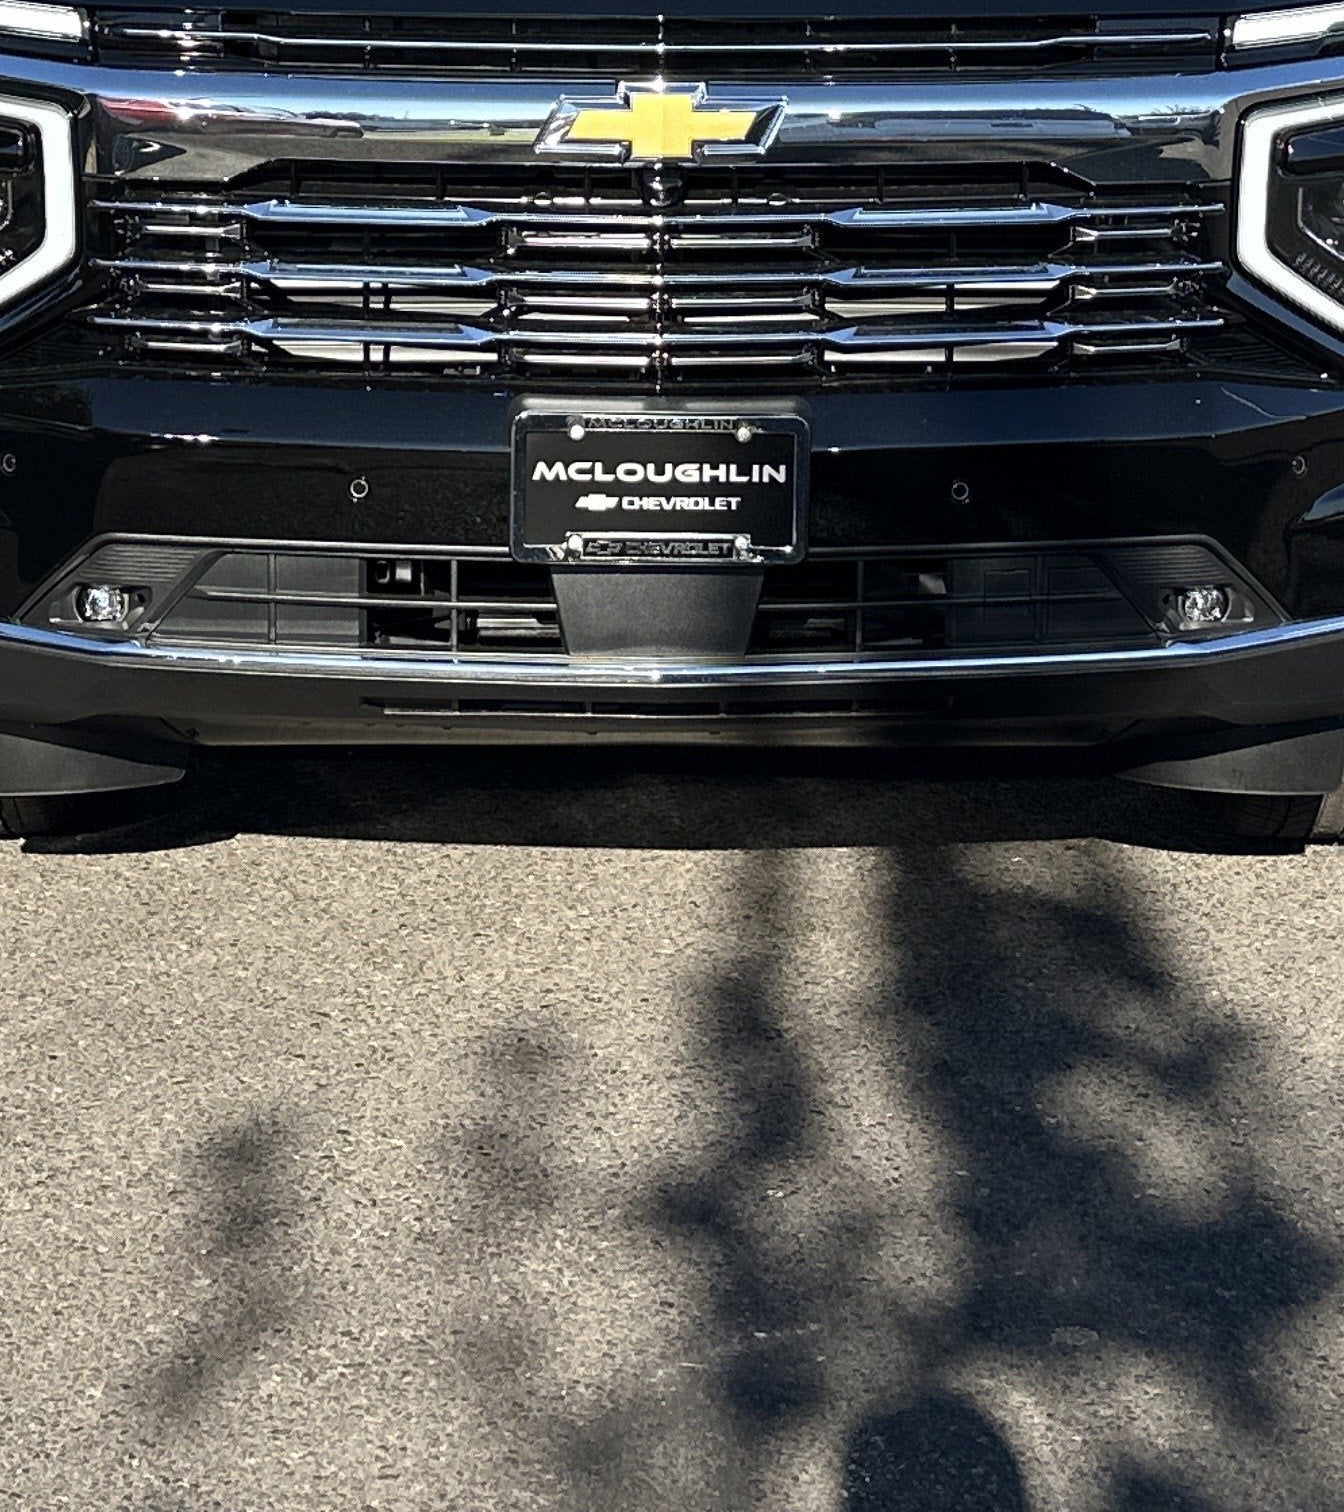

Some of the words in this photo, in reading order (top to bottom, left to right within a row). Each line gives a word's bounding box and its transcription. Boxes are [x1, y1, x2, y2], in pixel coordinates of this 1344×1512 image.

[587, 417, 735, 430] MCLOUGHLIN
[532, 461, 787, 483] MCLOUGHLIN
[621, 496, 742, 511] CHEVROLET
[625, 541, 732, 555] CHEVROLET
